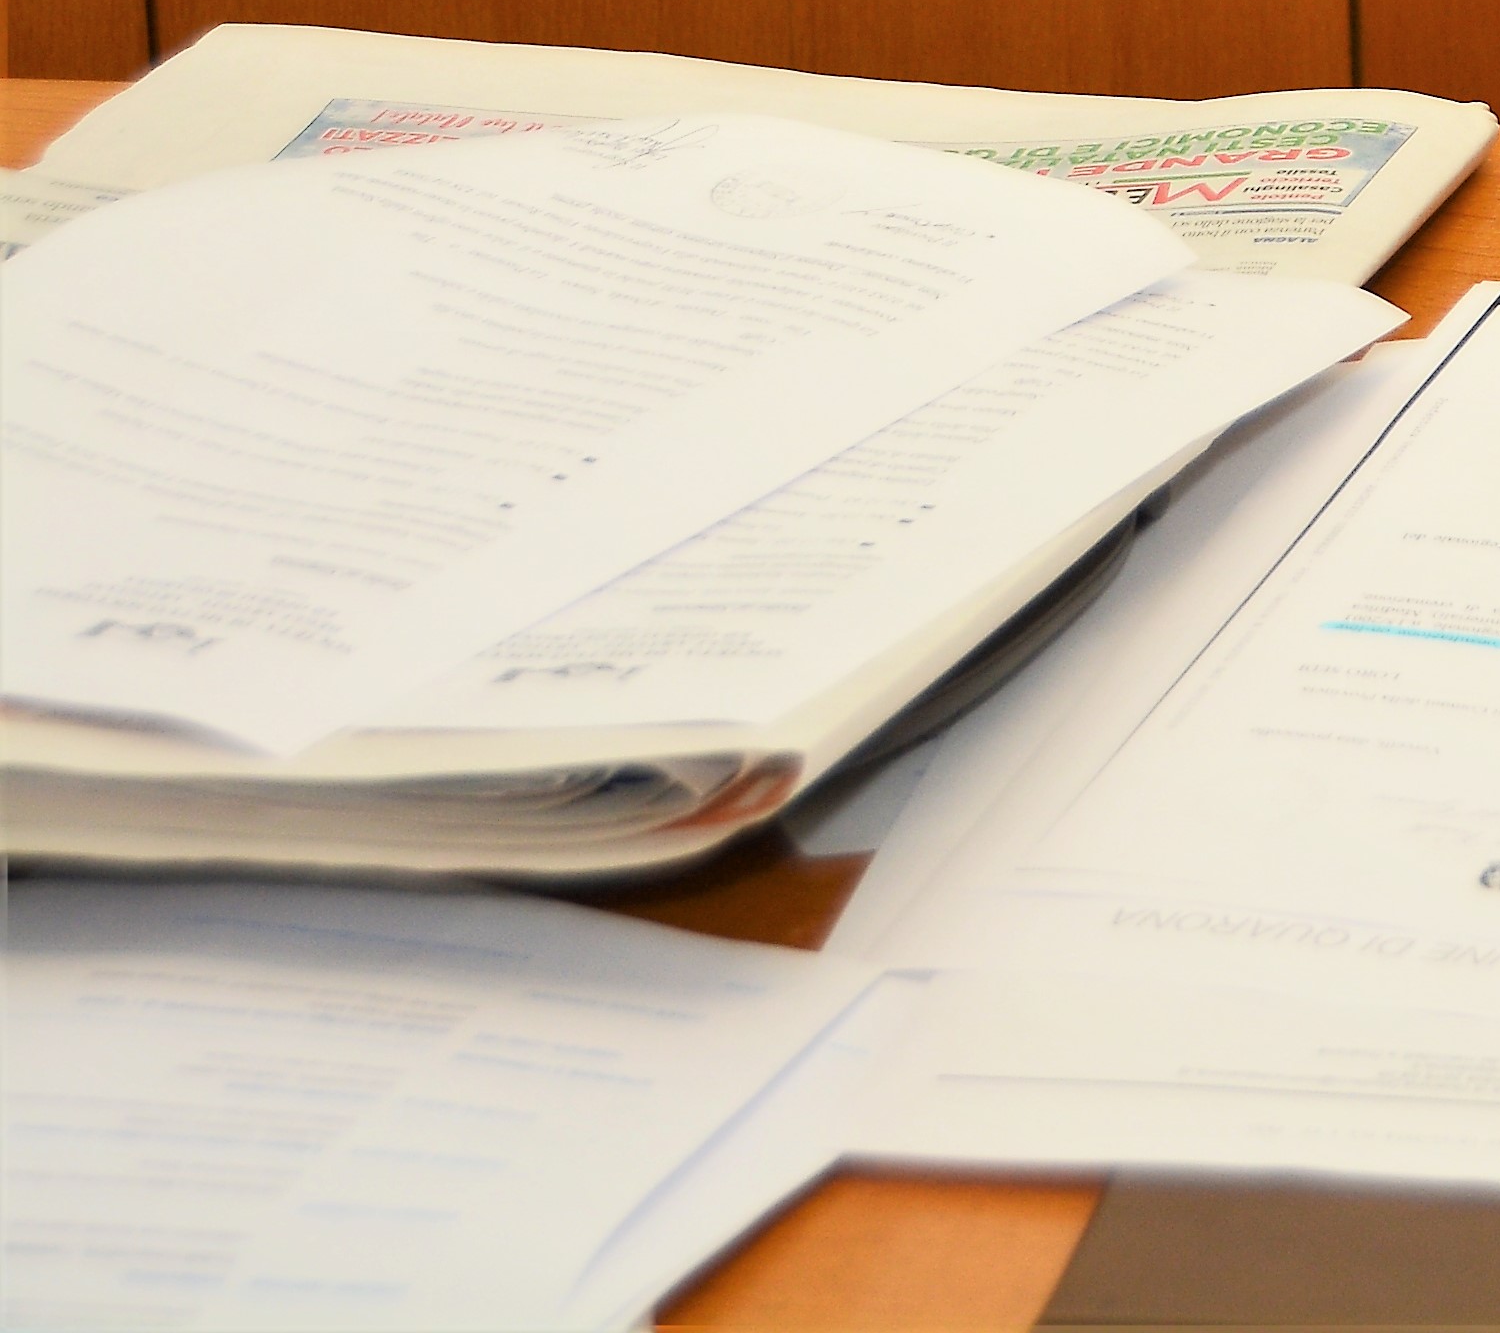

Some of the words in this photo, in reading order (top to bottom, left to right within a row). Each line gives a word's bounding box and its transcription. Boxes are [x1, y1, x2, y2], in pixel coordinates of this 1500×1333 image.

[1115, 121, 1389, 151] ECONOMICI
[1204, 134, 1339, 154] CESTI
[1068, 148, 1352, 178] GRANDE
[1243, 185, 1343, 194] Casalinghi
[1111, 907, 1352, 949] QUARONA
[1360, 935, 1416, 959] DI
